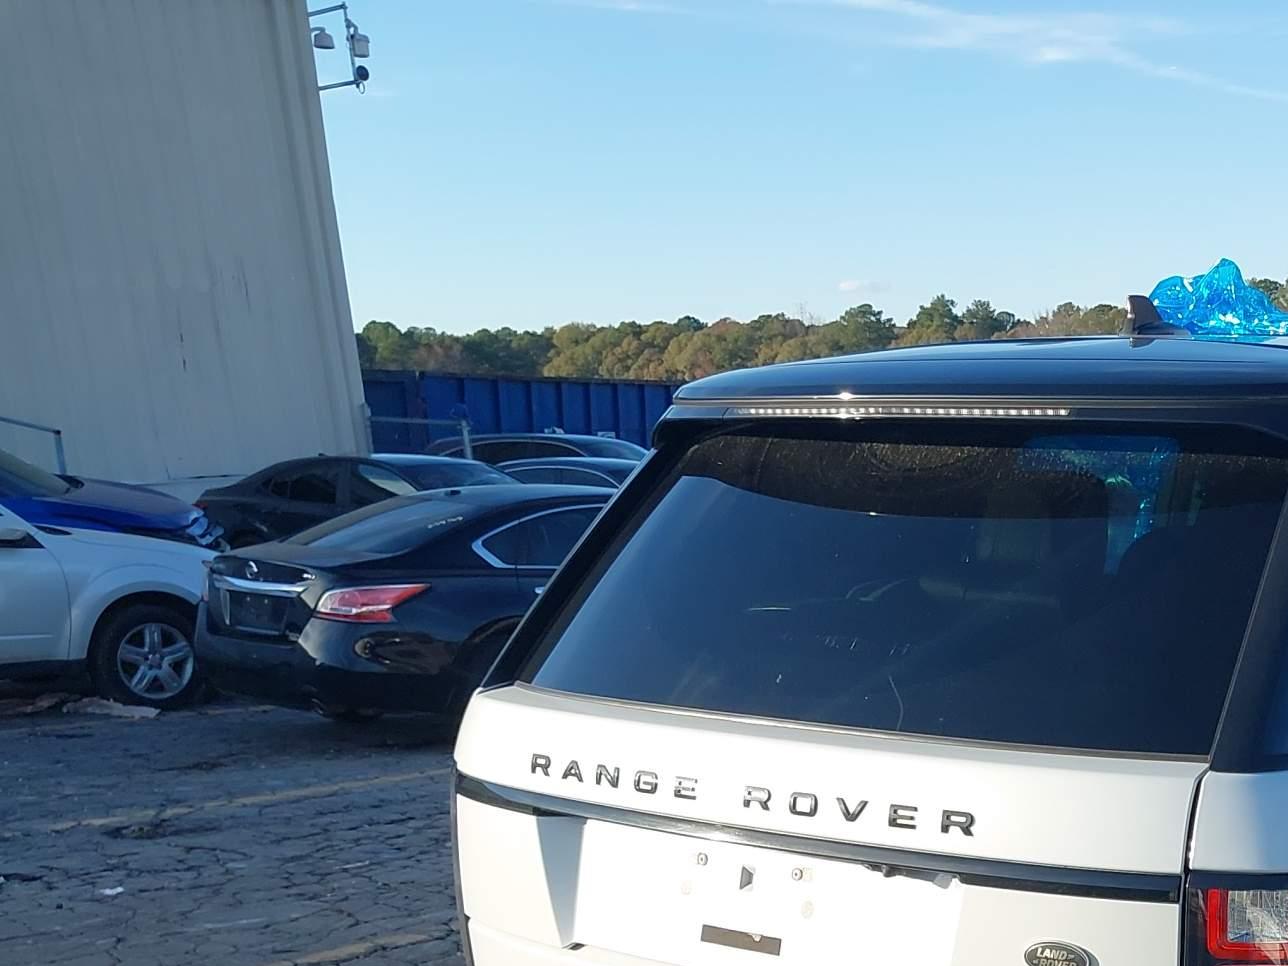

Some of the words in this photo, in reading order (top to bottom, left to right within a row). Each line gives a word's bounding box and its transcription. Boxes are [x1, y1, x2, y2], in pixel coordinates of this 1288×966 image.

[530, 753, 698, 801] RANGE
[743, 786, 976, 837] ROVER
[1036, 947, 1067, 960] LAND
